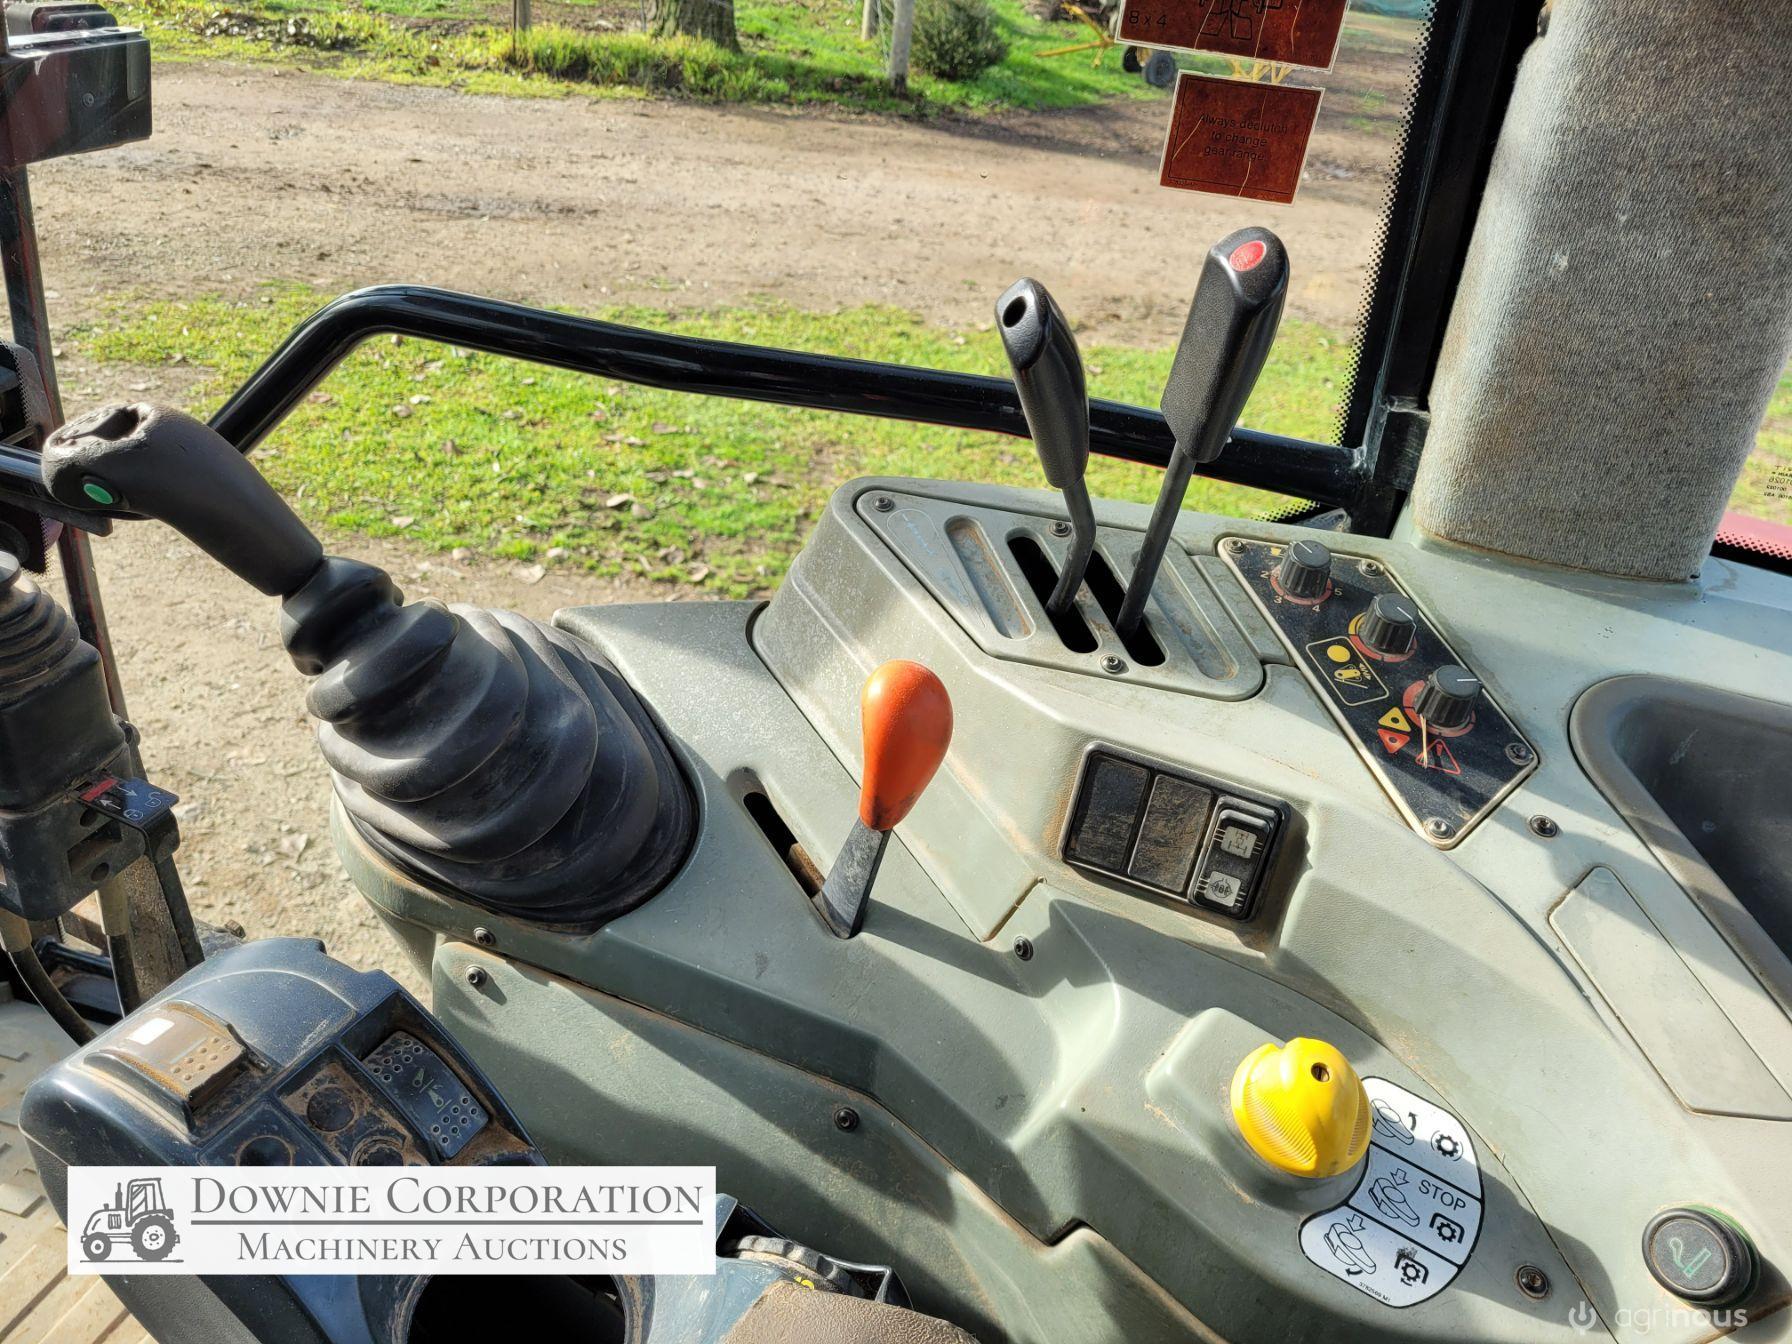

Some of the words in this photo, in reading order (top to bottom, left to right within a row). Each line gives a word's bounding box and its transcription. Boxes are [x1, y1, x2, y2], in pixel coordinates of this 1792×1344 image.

[1129, 11, 1140, 24] 8
[1157, 16, 1167, 28] 4
[1199, 113, 1236, 129] Always
[1239, 119, 1288, 135] declutch
[1211, 131, 1222, 141] to
[1225, 133, 1268, 148] change
[1204, 146, 1229, 157] gear
[1232, 150, 1265, 162] range
[1260, 570, 1270, 579] 2
[1274, 595, 1282, 604] 3
[1334, 588, 1343, 597] 5
[1312, 604, 1321, 613] 4
[1418, 1178, 1467, 1211] STOP
